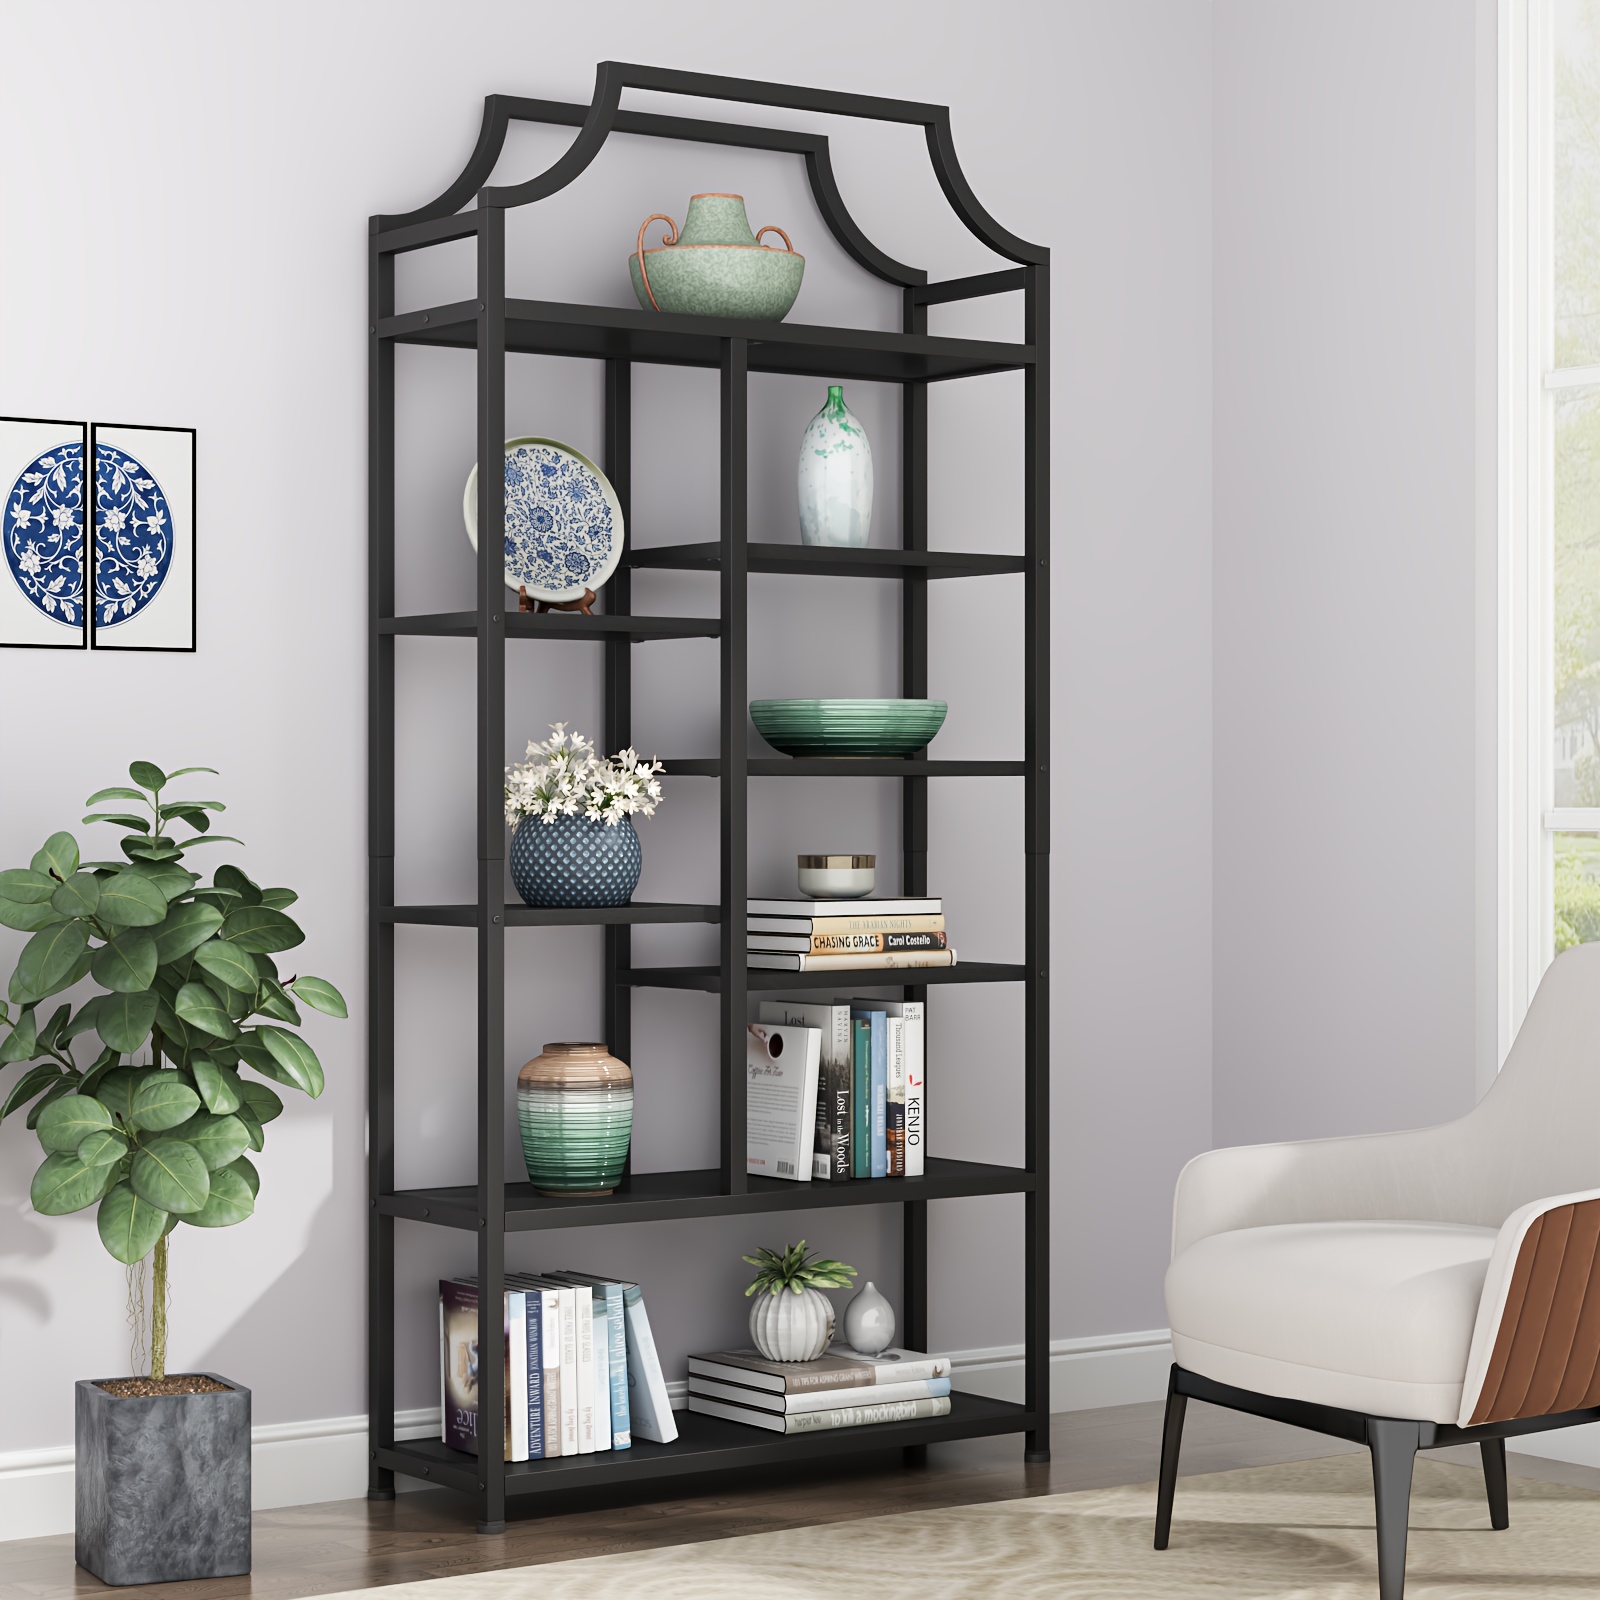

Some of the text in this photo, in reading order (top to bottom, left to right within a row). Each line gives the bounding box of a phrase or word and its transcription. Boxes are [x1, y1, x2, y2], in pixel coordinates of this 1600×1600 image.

[813, 935, 880, 949] CHASING GRACE
[888, 934, 931, 946] Carol Costello
[784, 1010, 805, 1026] Lost
[894, 1022, 903, 1079] Thousand Leagues
[836, 1090, 849, 1116] Lost
[907, 1097, 920, 1146] KENJO
[836, 1131, 849, 1174] Woods
[529, 1343, 540, 1371] JONATHAN
[456, 1408, 478, 1437] lice
[529, 1372, 541, 1454] ADVENTURE INWARD
[830, 1401, 917, 1426] to kill a mockingbird
